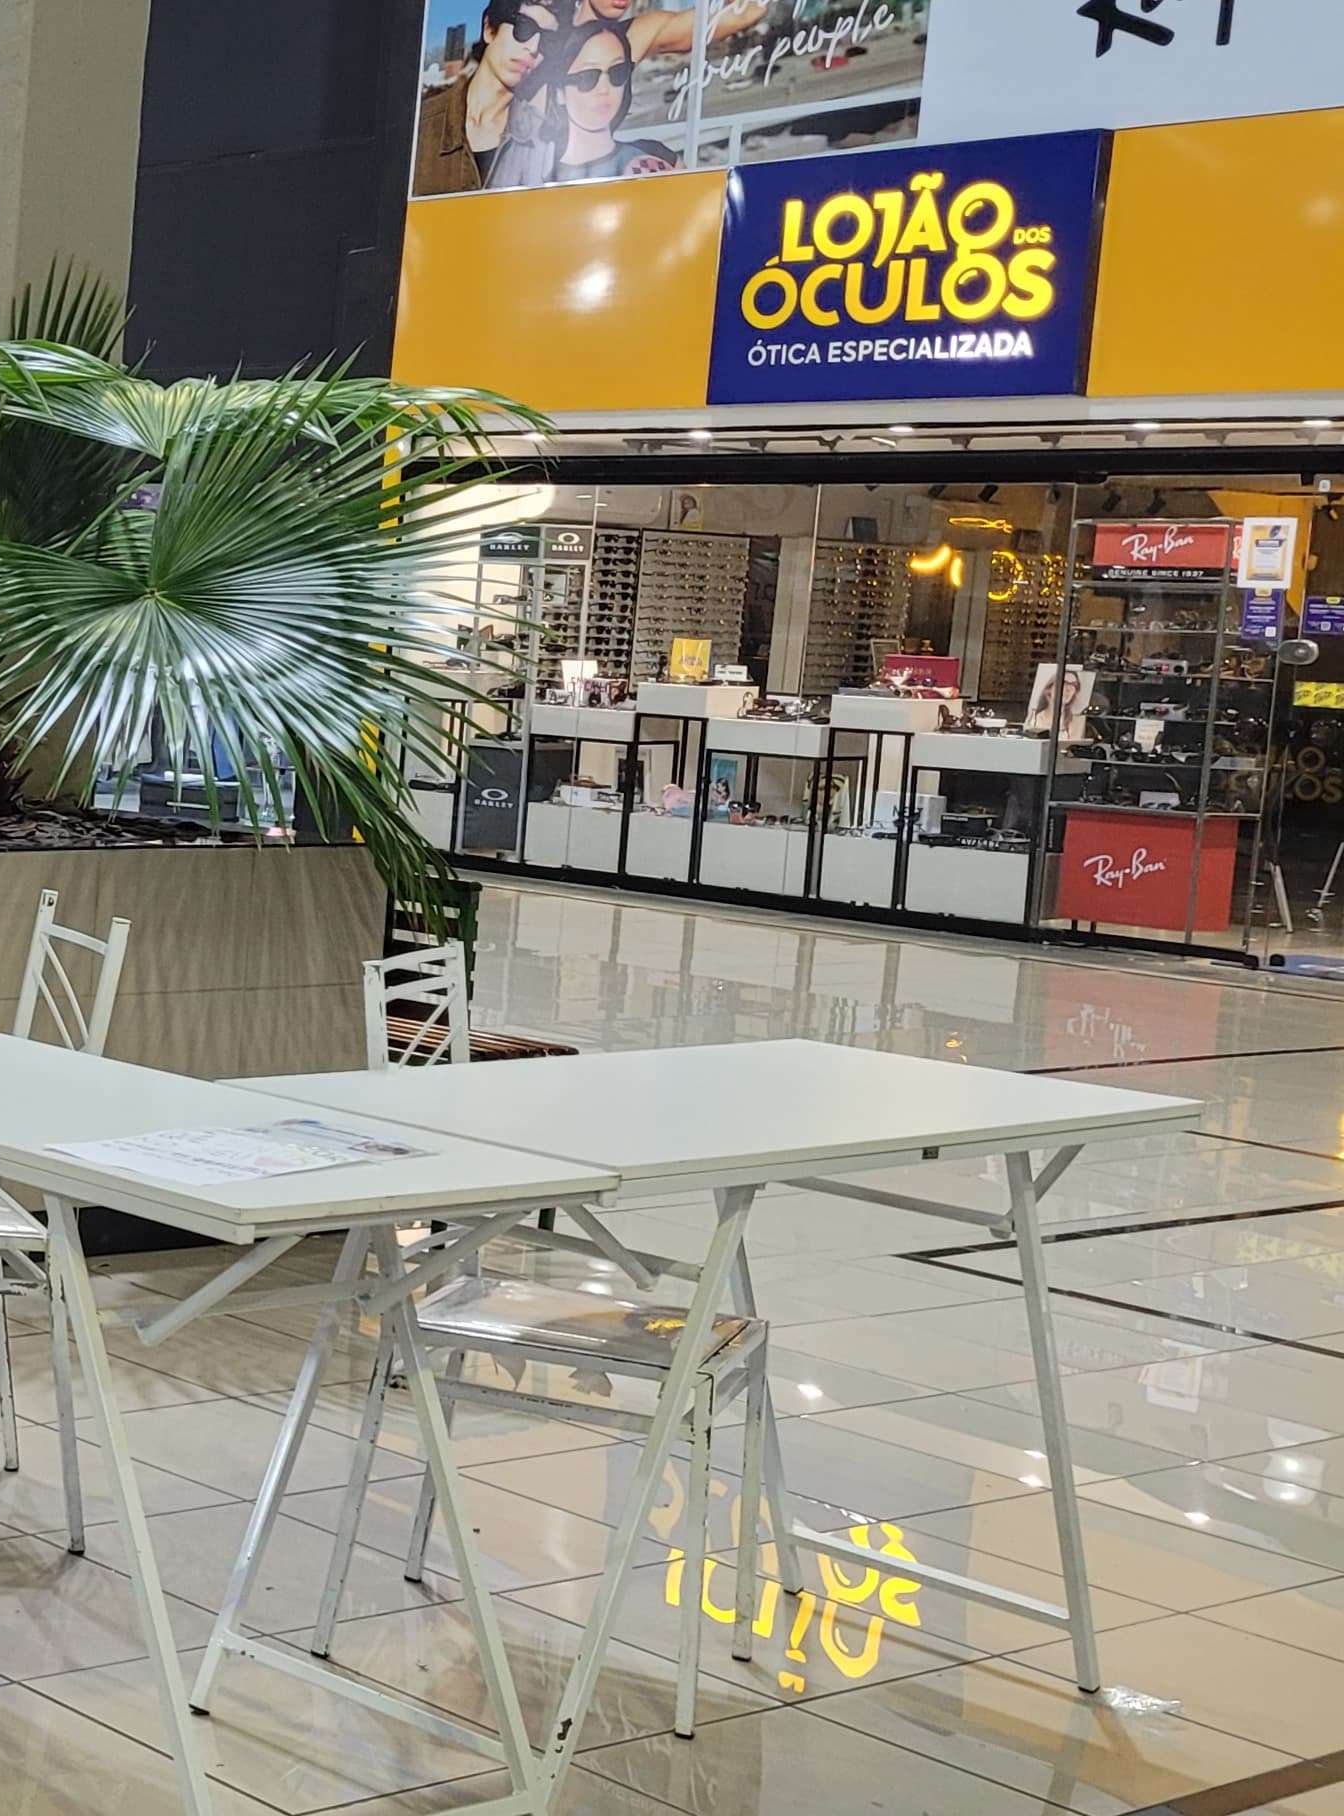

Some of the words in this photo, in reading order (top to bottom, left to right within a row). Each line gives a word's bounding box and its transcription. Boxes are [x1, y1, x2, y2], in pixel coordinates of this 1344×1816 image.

[763, 4, 895, 88] people
[781, 172, 1014, 268] LOJÃO
[1013, 226, 1052, 246] DOS
[740, 249, 1057, 330] ÓCULOS
[747, 339, 822, 367] ÓTICA
[827, 330, 1035, 364] ESPECIALIZADA
